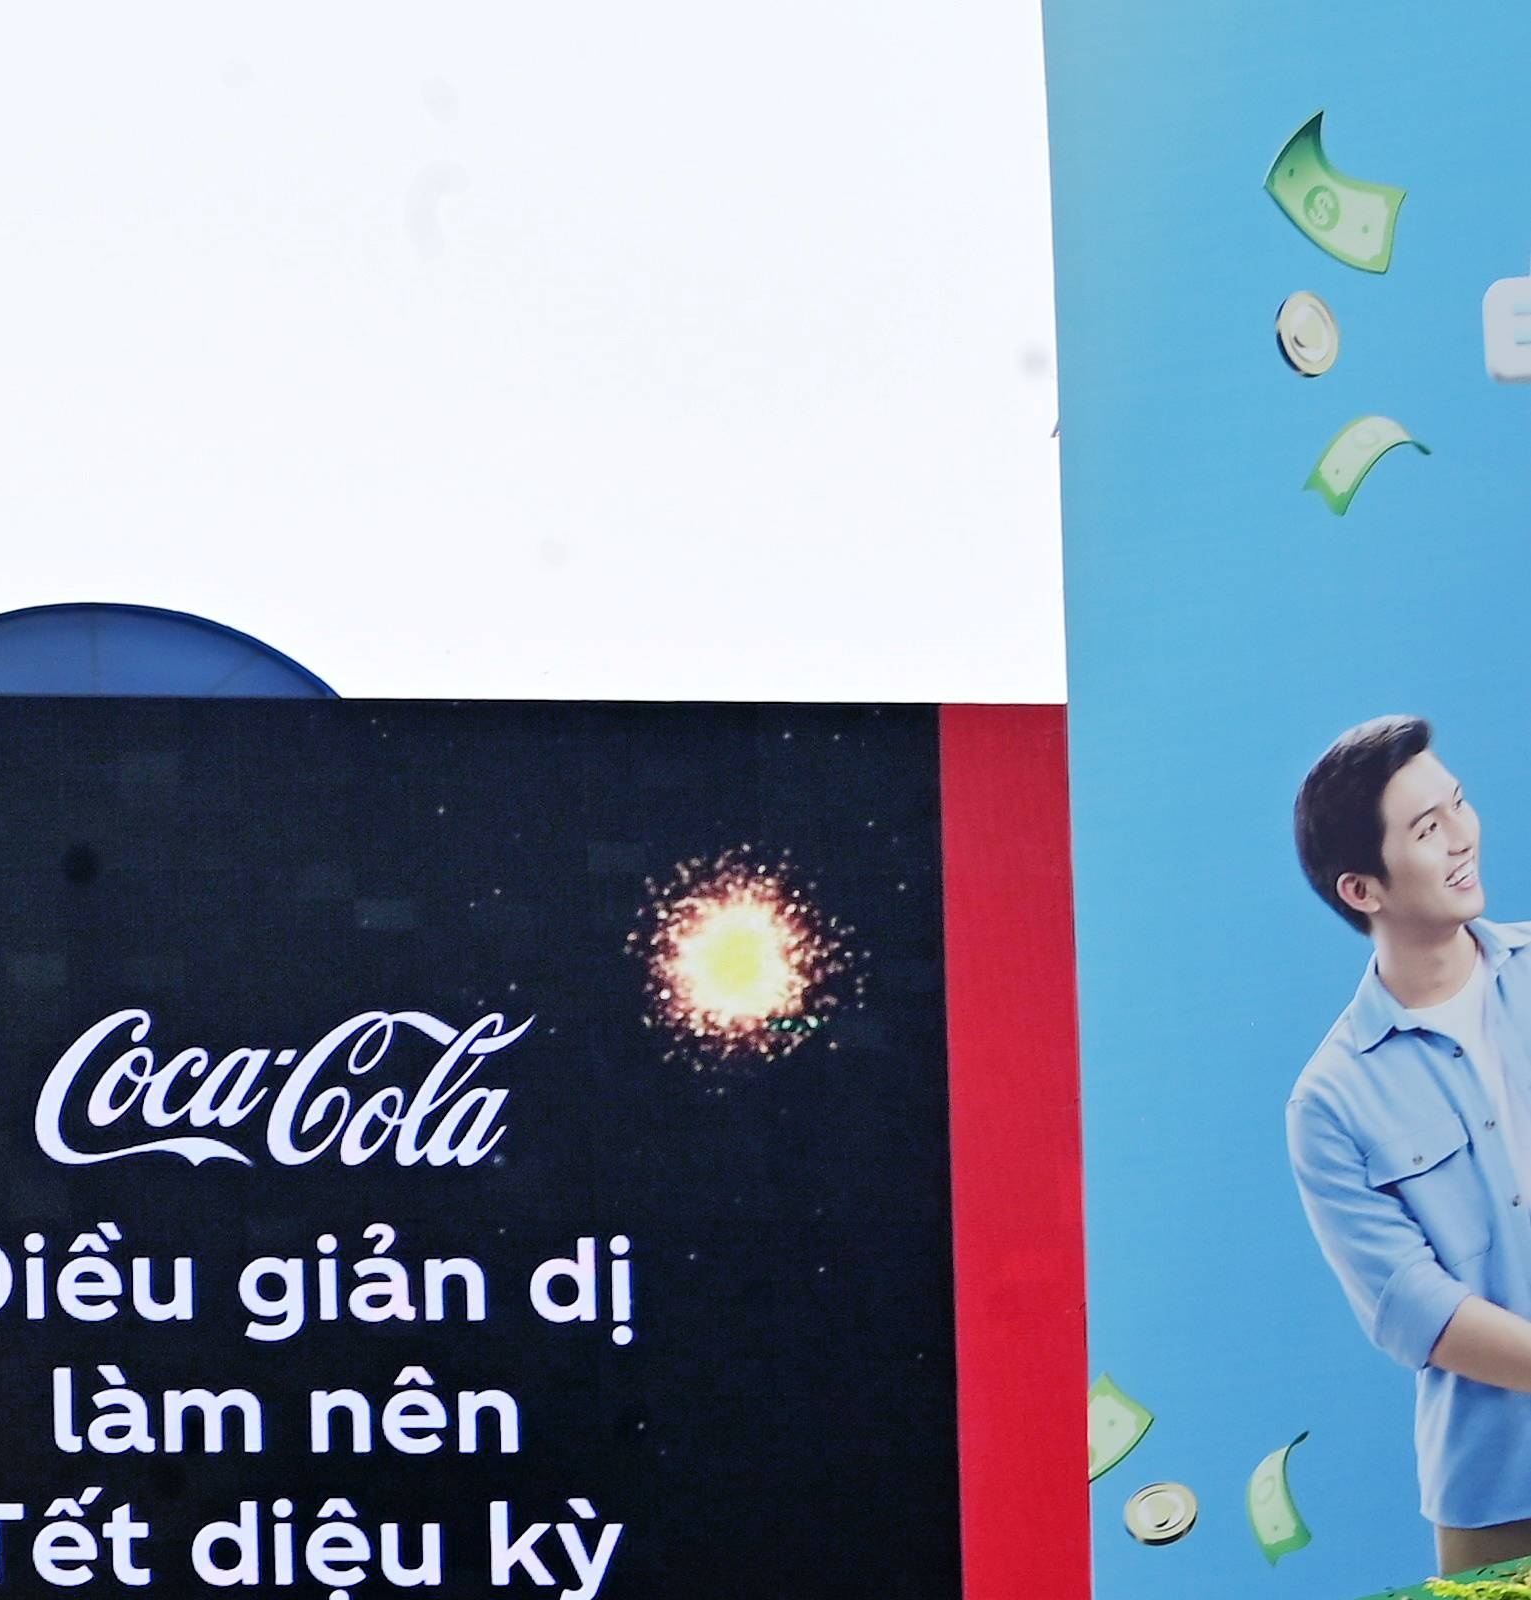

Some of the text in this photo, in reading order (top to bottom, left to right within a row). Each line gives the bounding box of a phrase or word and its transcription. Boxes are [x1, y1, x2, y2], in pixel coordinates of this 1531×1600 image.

[34, 1007, 536, 1167] Coca-Cola
[237, 1222, 487, 1341] giản
[528, 1234, 634, 1345] dị
[51, 1363, 520, 1454] làm nên
